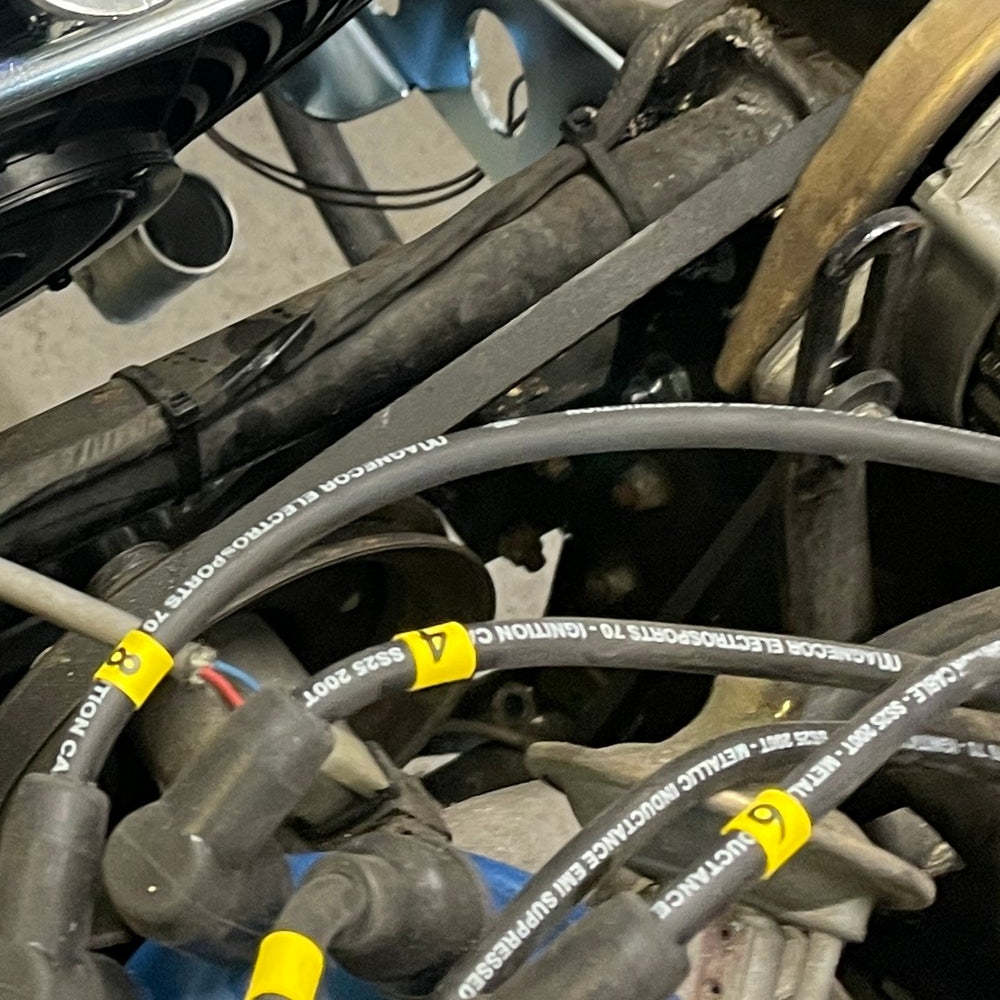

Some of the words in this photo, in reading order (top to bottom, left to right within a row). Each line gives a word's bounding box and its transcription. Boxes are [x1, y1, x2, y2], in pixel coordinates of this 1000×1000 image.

[320, 435, 448, 495] MAGNECOR
[164, 489, 320, 615] ELECTROSPORTS
[142, 610, 171, 633] 70
[495, 622, 588, 643] IGNITION
[600, 623, 626, 640] 70
[627, 624, 785, 655] ELECTROSPORTS
[107, 647, 141, 675] 8
[351, 646, 406, 677] SS25
[677, 742, 751, 792] METALLIC
[583, 782, 681, 870] INDUCTANCE
[552, 861, 589, 898] EMI
[457, 890, 559, 1000] SUPPRESSED
